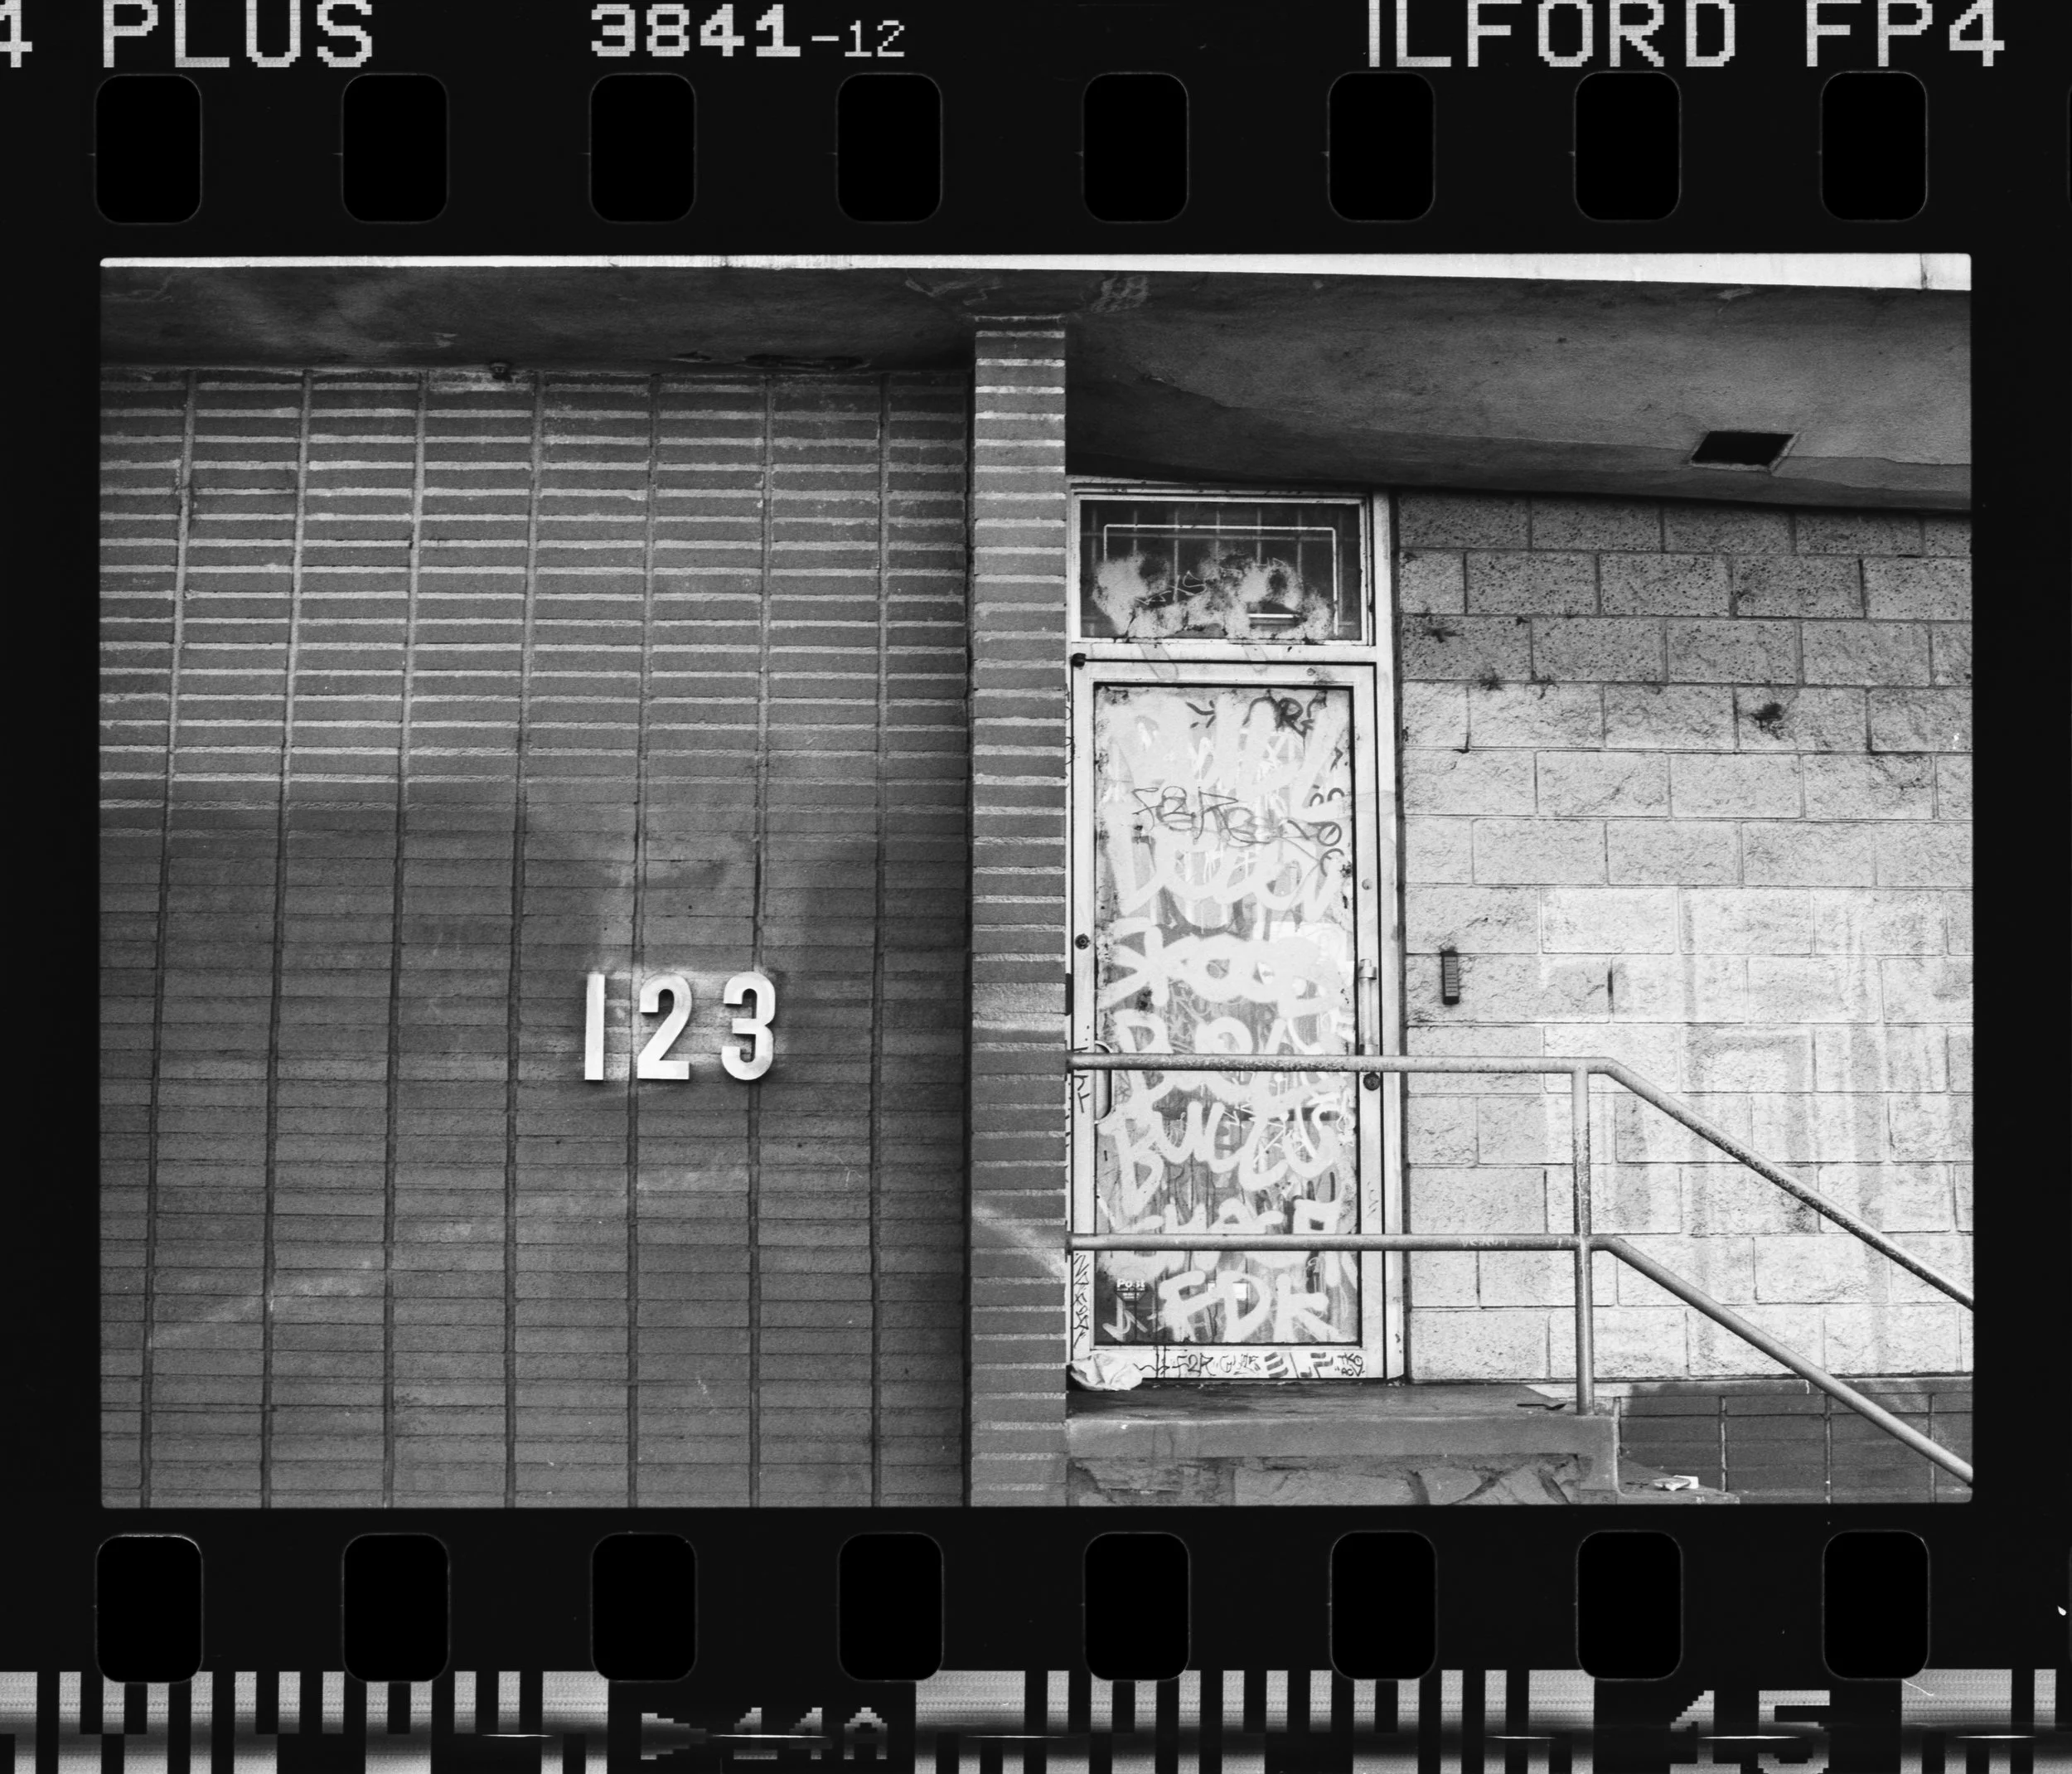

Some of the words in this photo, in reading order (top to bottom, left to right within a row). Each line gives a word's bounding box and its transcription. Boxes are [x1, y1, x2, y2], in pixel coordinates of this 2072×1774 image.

[104, 0, 372, 67] PLUS
[1369, 0, 1735, 67] ILFORD
[1807, 0, 2005, 67] FP4
[584, 972, 776, 1080] 123
[1669, 1689, 1831, 1774] 15
